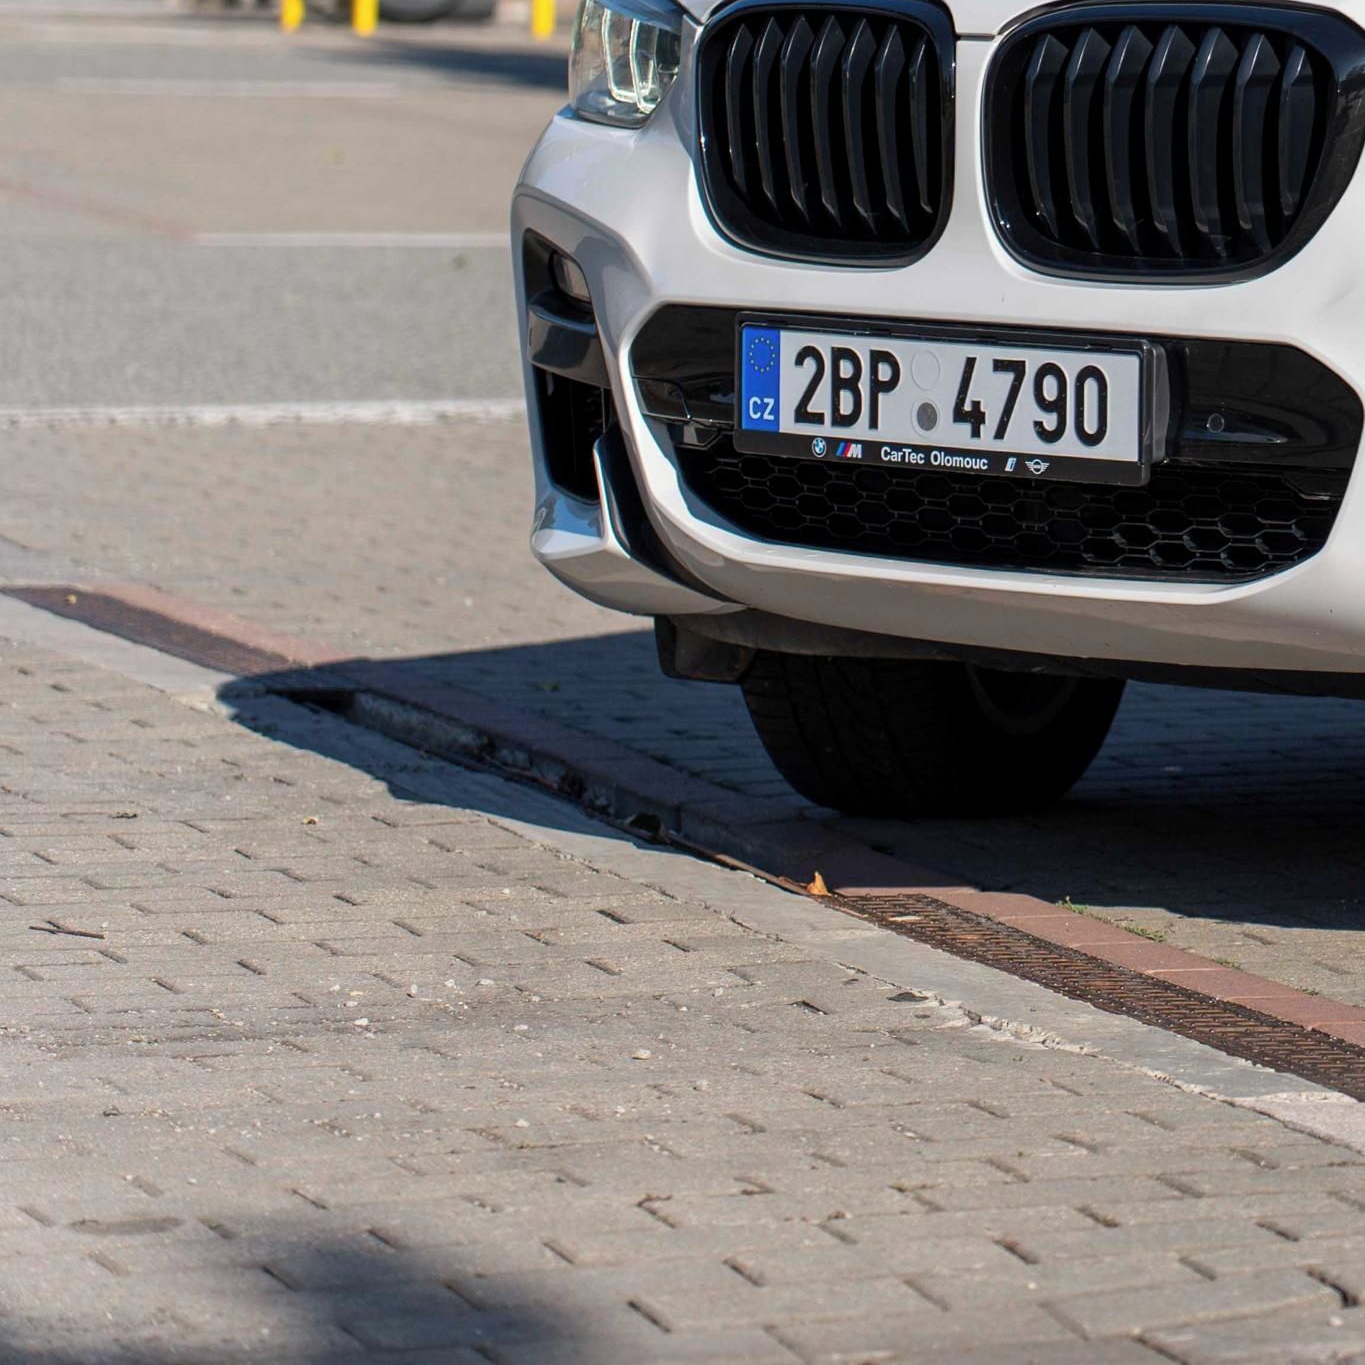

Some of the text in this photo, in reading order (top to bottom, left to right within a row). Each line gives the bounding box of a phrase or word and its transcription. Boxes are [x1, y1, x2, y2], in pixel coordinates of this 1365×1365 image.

[749, 396, 775, 420] CZ
[794, 345, 1108, 447] 2BP 4790
[880, 446, 988, 470] CarTec Olomouc
